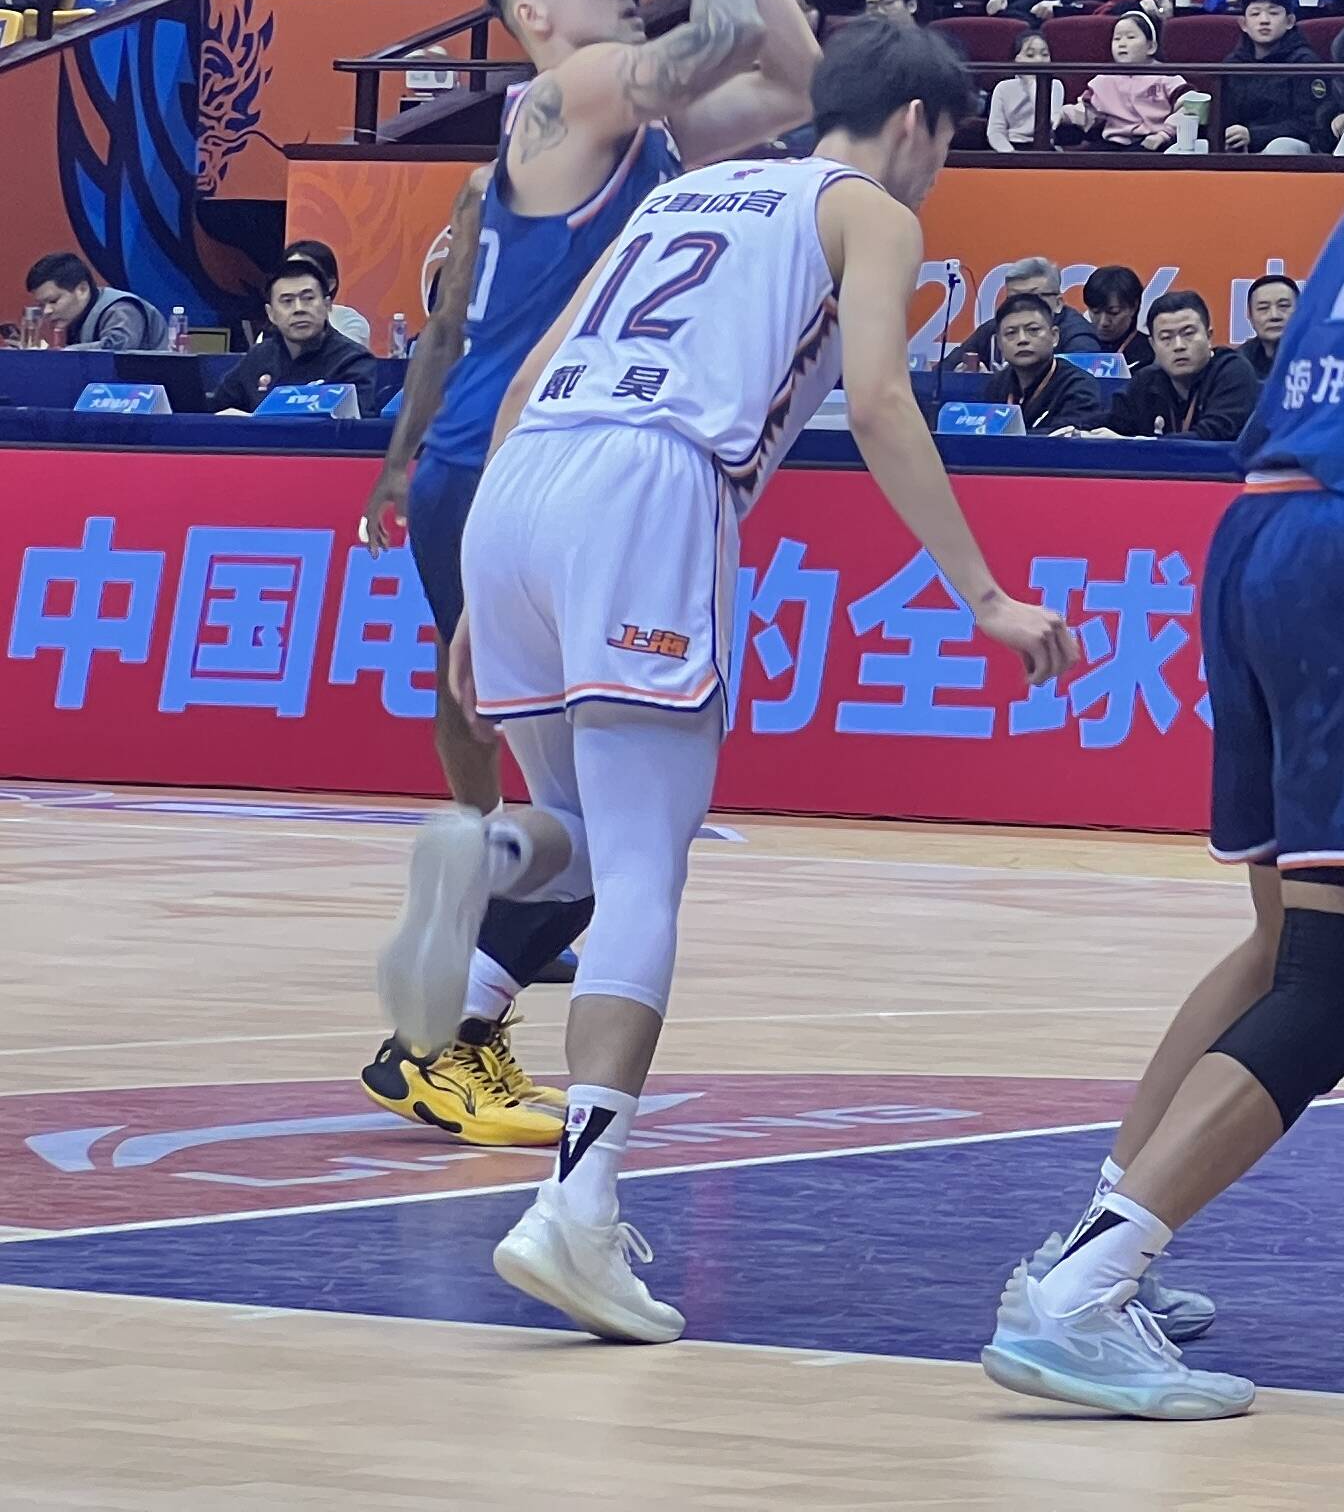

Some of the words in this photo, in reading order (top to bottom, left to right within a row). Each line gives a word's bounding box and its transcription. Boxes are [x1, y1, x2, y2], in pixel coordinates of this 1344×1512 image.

[632, 190, 787, 225] 久事体育
[574, 230, 730, 341] 12
